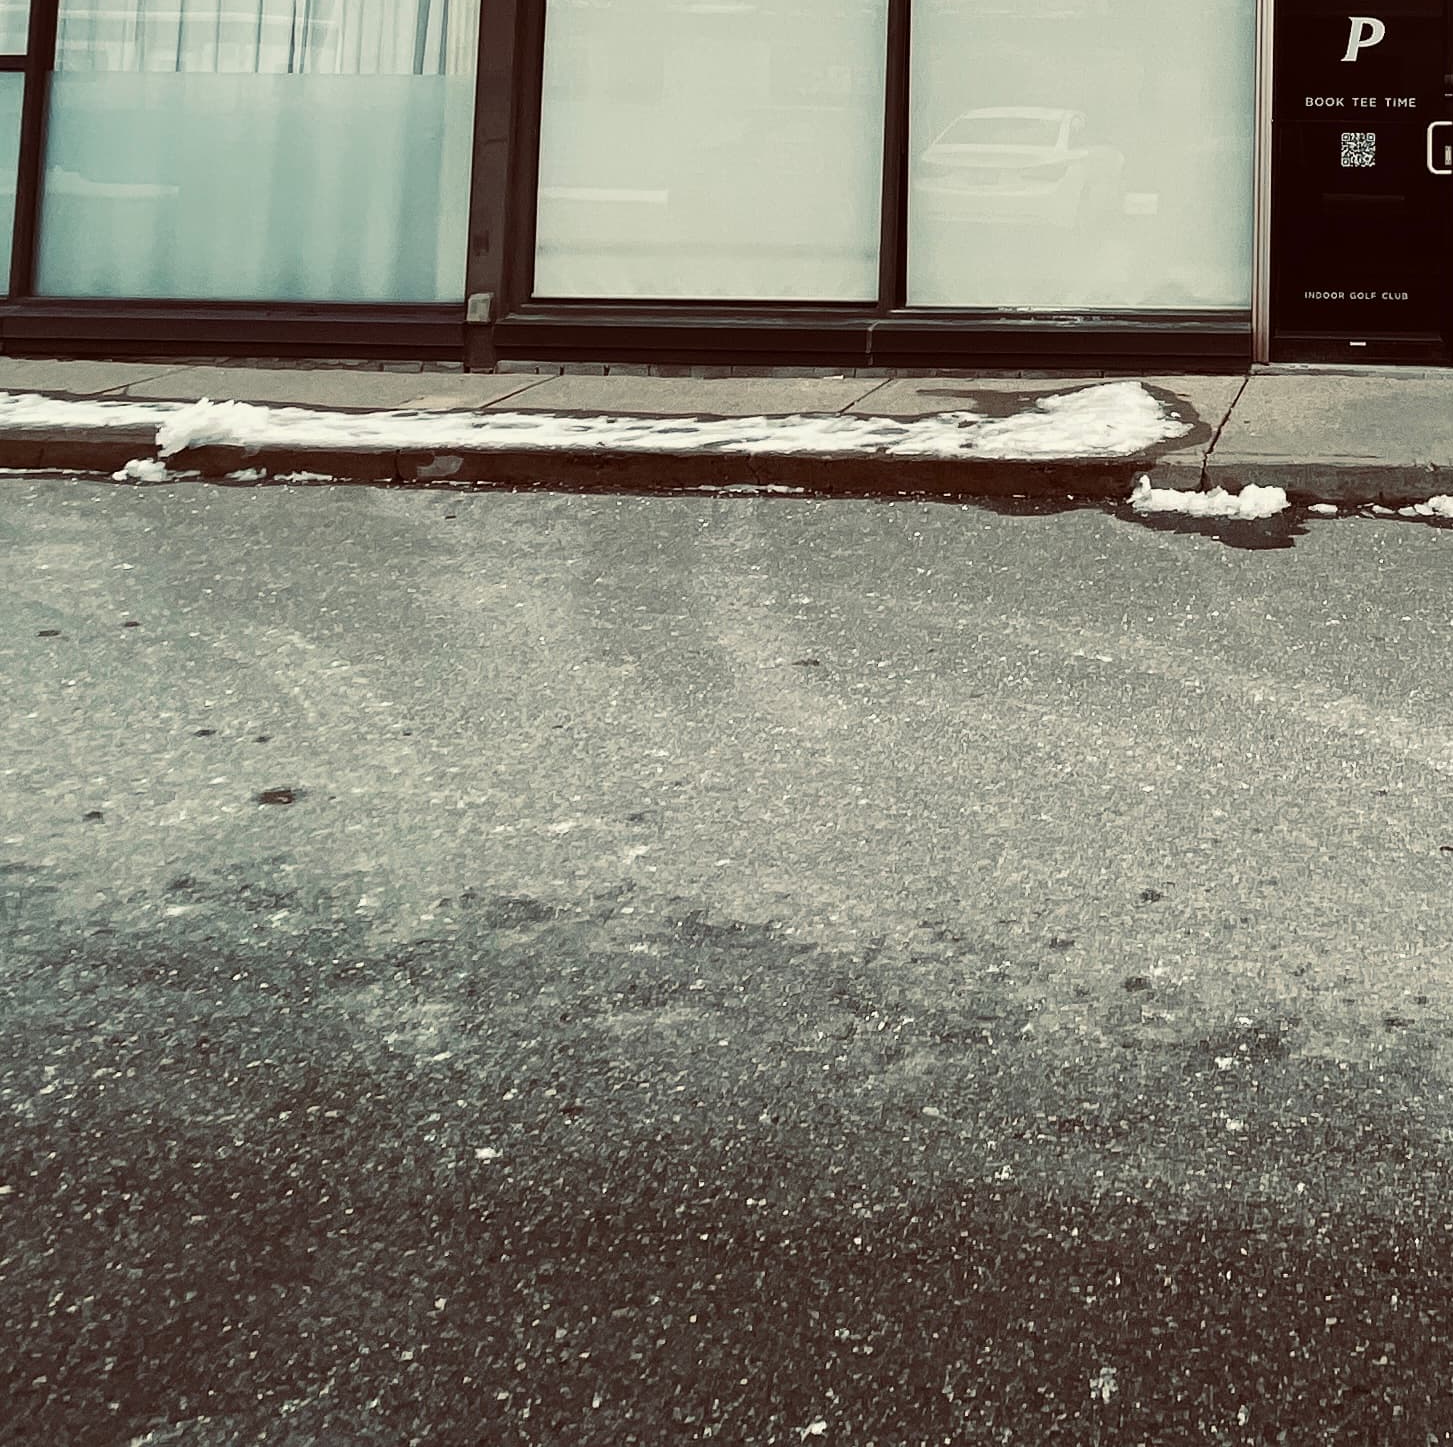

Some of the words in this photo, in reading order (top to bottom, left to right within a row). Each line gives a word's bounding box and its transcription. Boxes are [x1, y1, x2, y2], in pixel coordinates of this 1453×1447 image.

[1340, 16, 1386, 62] P
[1304, 96, 1345, 107] BOOK
[1351, 97, 1377, 108] TEE
[1384, 97, 1417, 108] TIME
[1304, 291, 1345, 300] INDOOR
[1349, 291, 1377, 300] GOLF
[1381, 291, 1409, 301] CLUB
